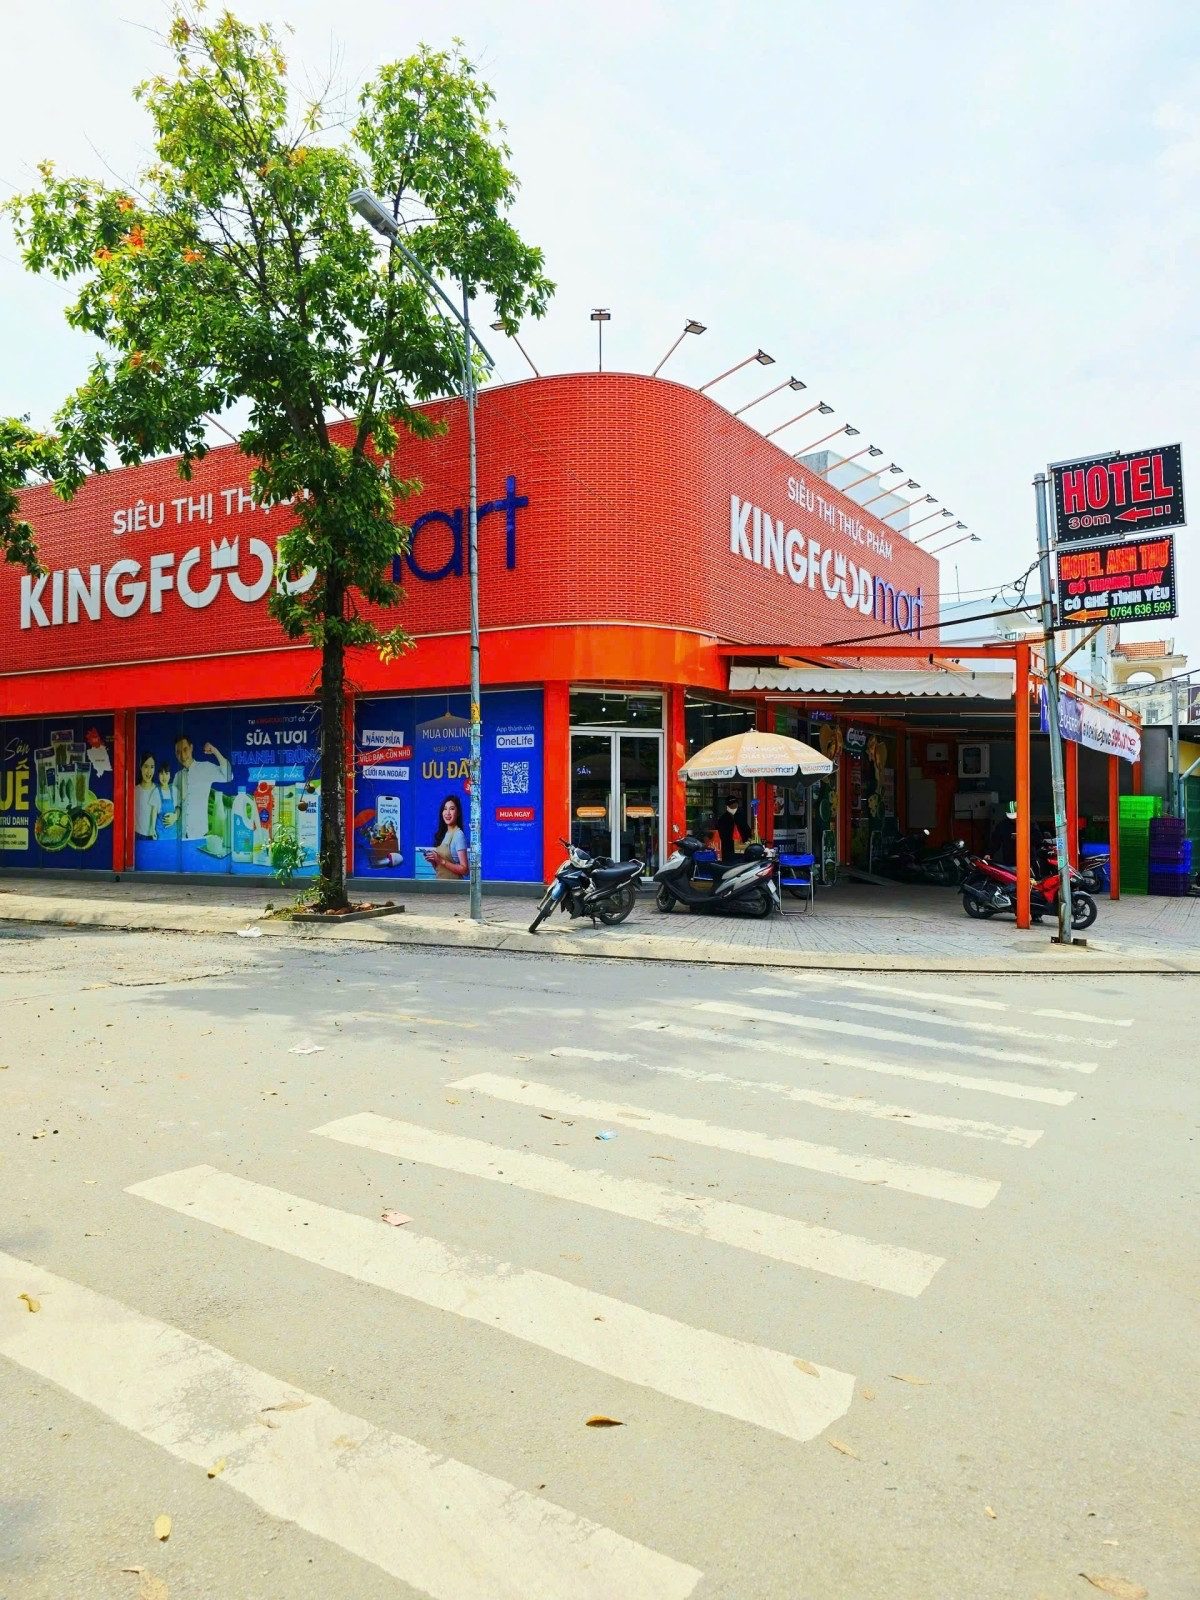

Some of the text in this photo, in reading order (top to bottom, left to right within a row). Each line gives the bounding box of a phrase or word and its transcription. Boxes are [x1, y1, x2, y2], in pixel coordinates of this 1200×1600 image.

[1062, 455, 1173, 514] HOTEL
[113, 499, 165, 535] SIÊU
[171, 492, 213, 525] THỊ
[787, 476, 814, 512] SIÊU
[817, 496, 835, 532] THỊ
[838, 510, 864, 546] THỰC
[1068, 513, 1111, 530] 30m
[1061, 552, 1103, 580] HOTEL
[1063, 595, 1082, 612] CÓ
[1144, 585, 1170, 602] YÊU
[1109, 601, 1172, 619] 0764 636 599
[246, 728, 308, 746] SỮA TƯƠI
[422, 728, 441, 739] MUA
[497, 736, 533, 747] OneLife
[422, 757, 470, 779] ƯU ĐÃ
